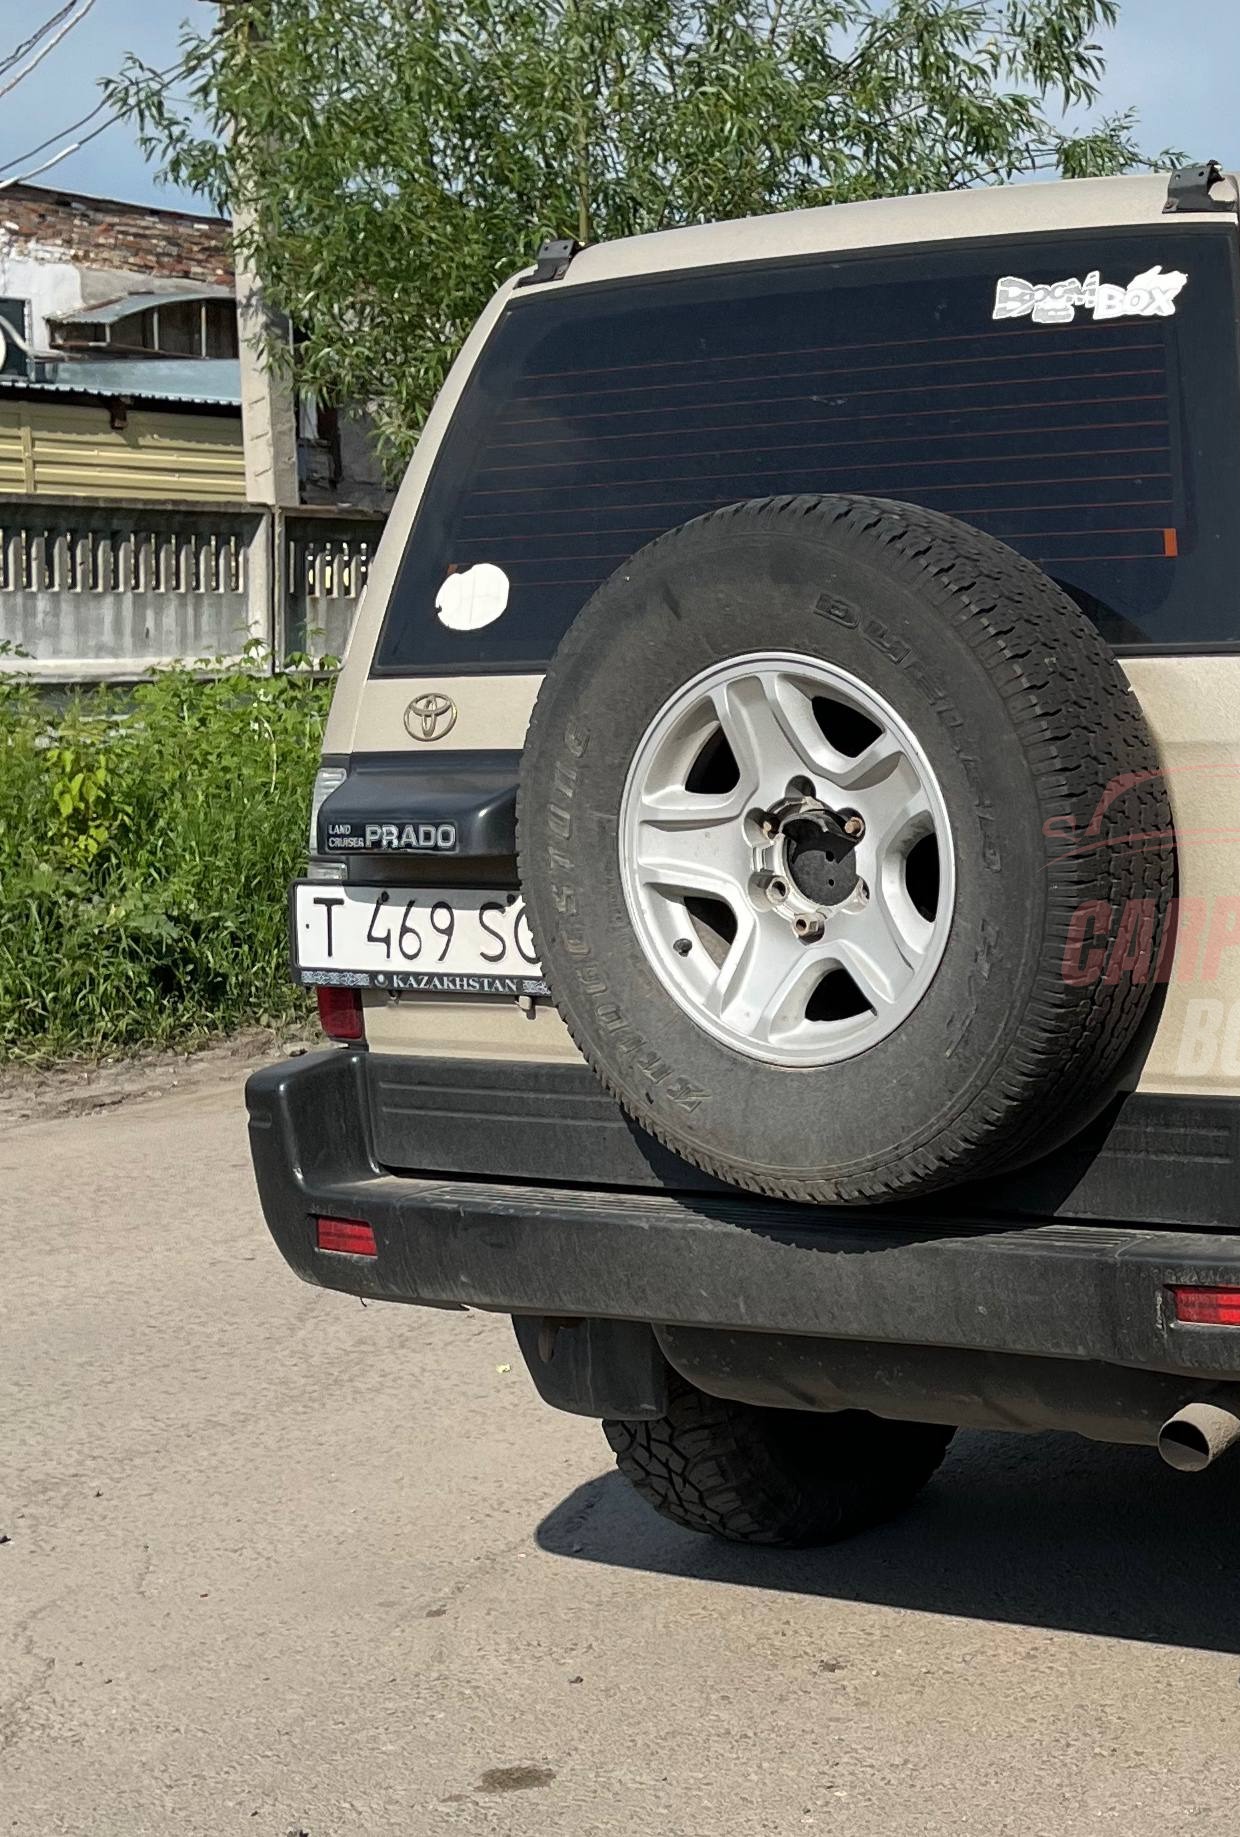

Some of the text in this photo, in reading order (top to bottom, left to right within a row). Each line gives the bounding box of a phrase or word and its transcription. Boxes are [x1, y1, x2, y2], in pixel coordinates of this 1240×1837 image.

[328, 824, 352, 835] LAND
[365, 824, 456, 849] PRADO
[328, 837, 365, 848] CRUISER
[313, 897, 345, 958] T
[367, 896, 455, 962] 469
[393, 974, 518, 992] KAZAKHSTAN
